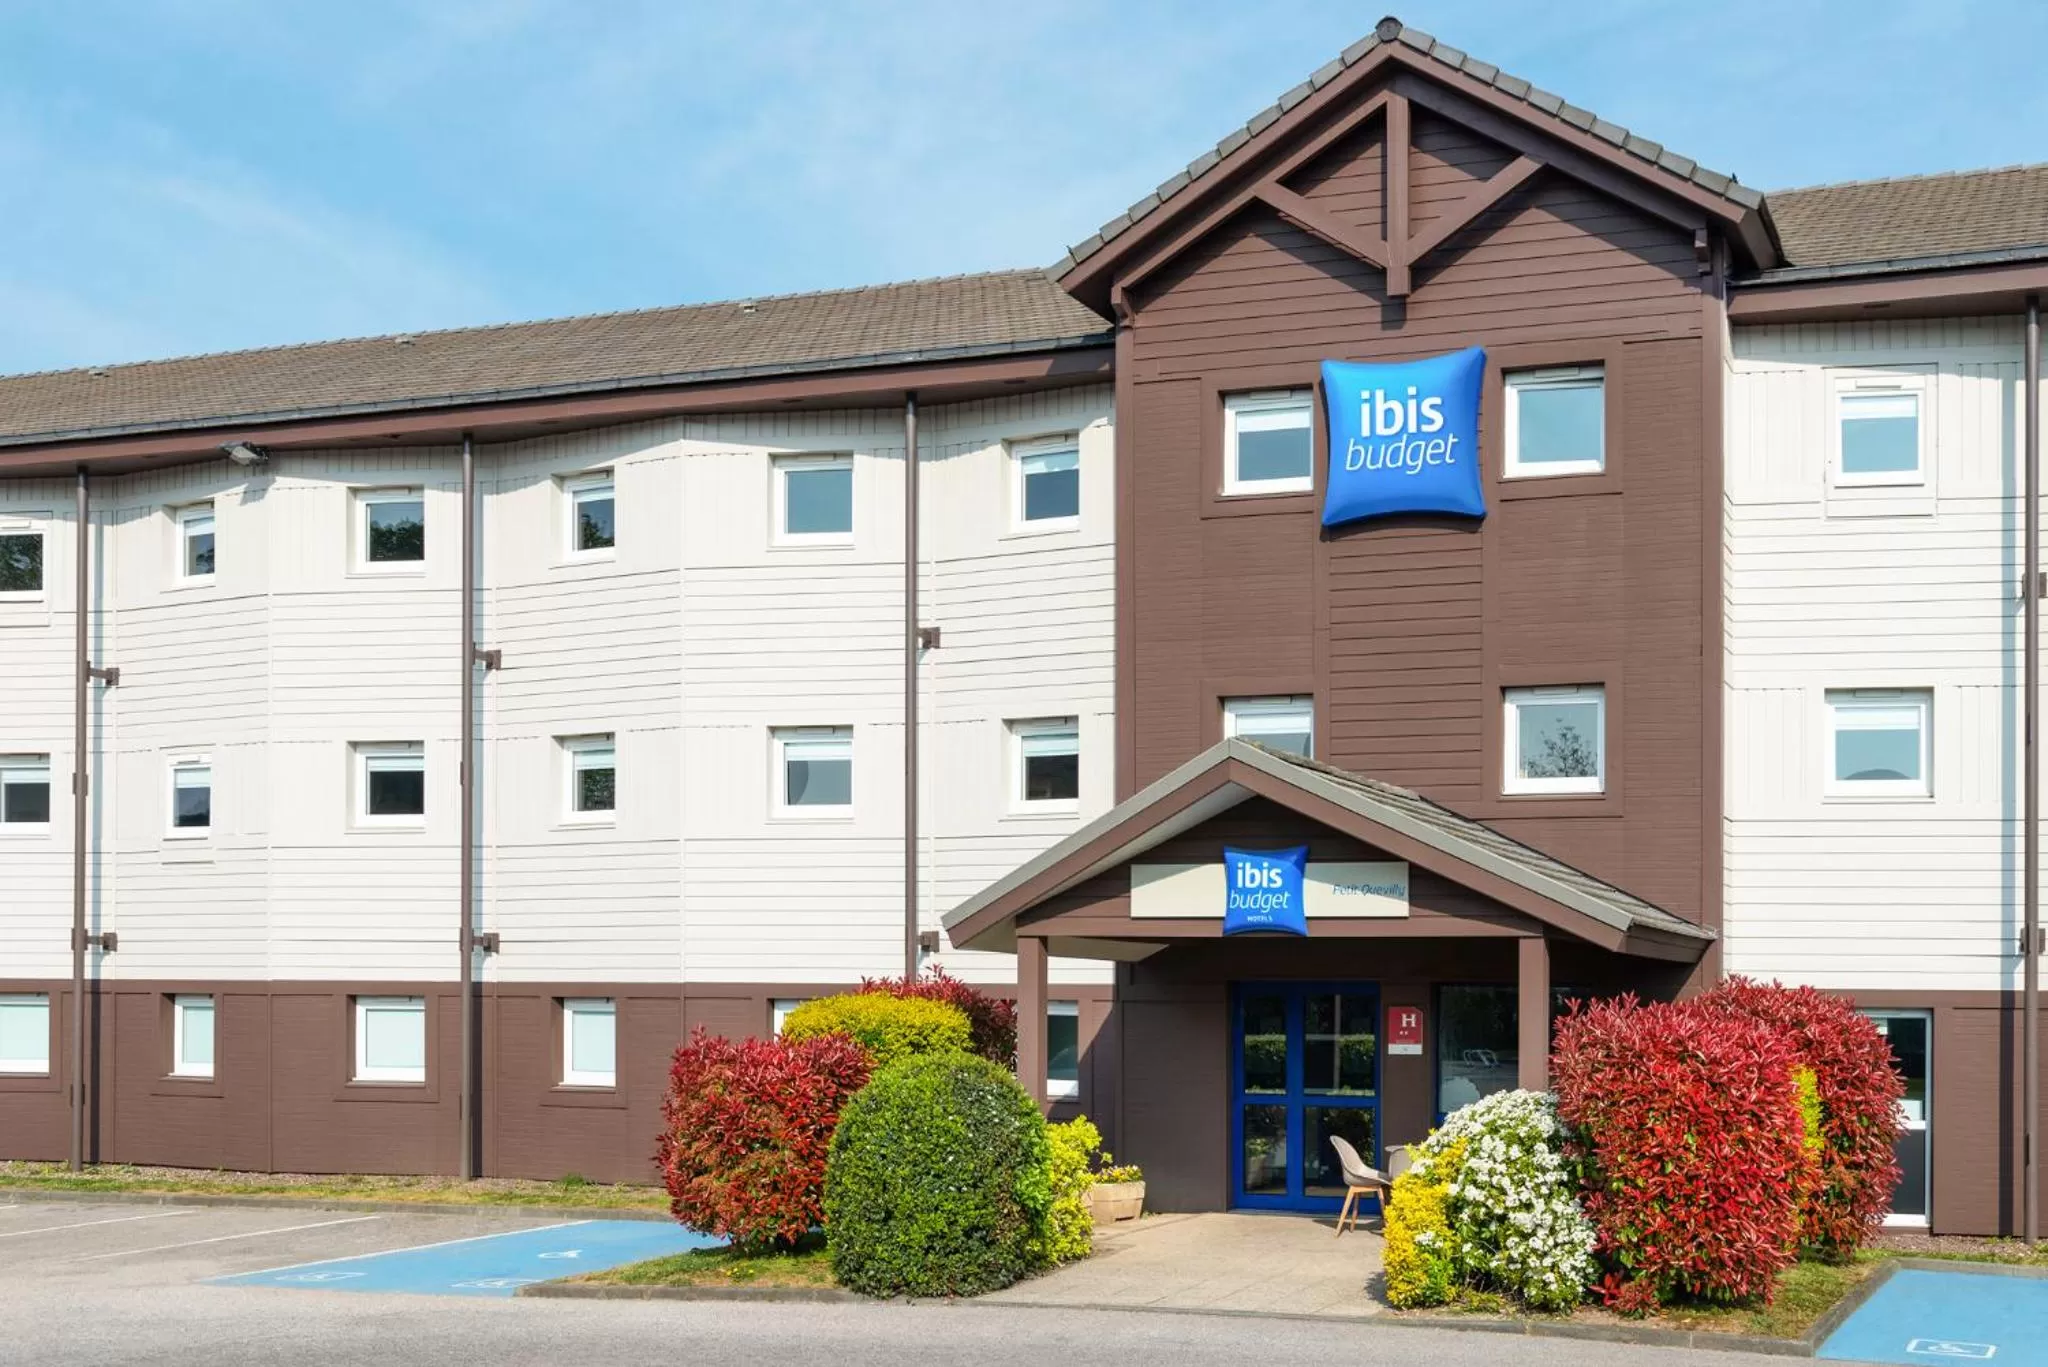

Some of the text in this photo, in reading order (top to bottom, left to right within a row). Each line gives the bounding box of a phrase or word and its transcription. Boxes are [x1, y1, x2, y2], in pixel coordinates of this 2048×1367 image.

[1360, 386, 1444, 437] ibis
[1345, 433, 1458, 475] budget
[1237, 861, 1283, 889] ibis
[1229, 889, 1292, 913] budget
[1360, 883, 1406, 897] Quevilly
[1401, 1013, 1417, 1028] H
